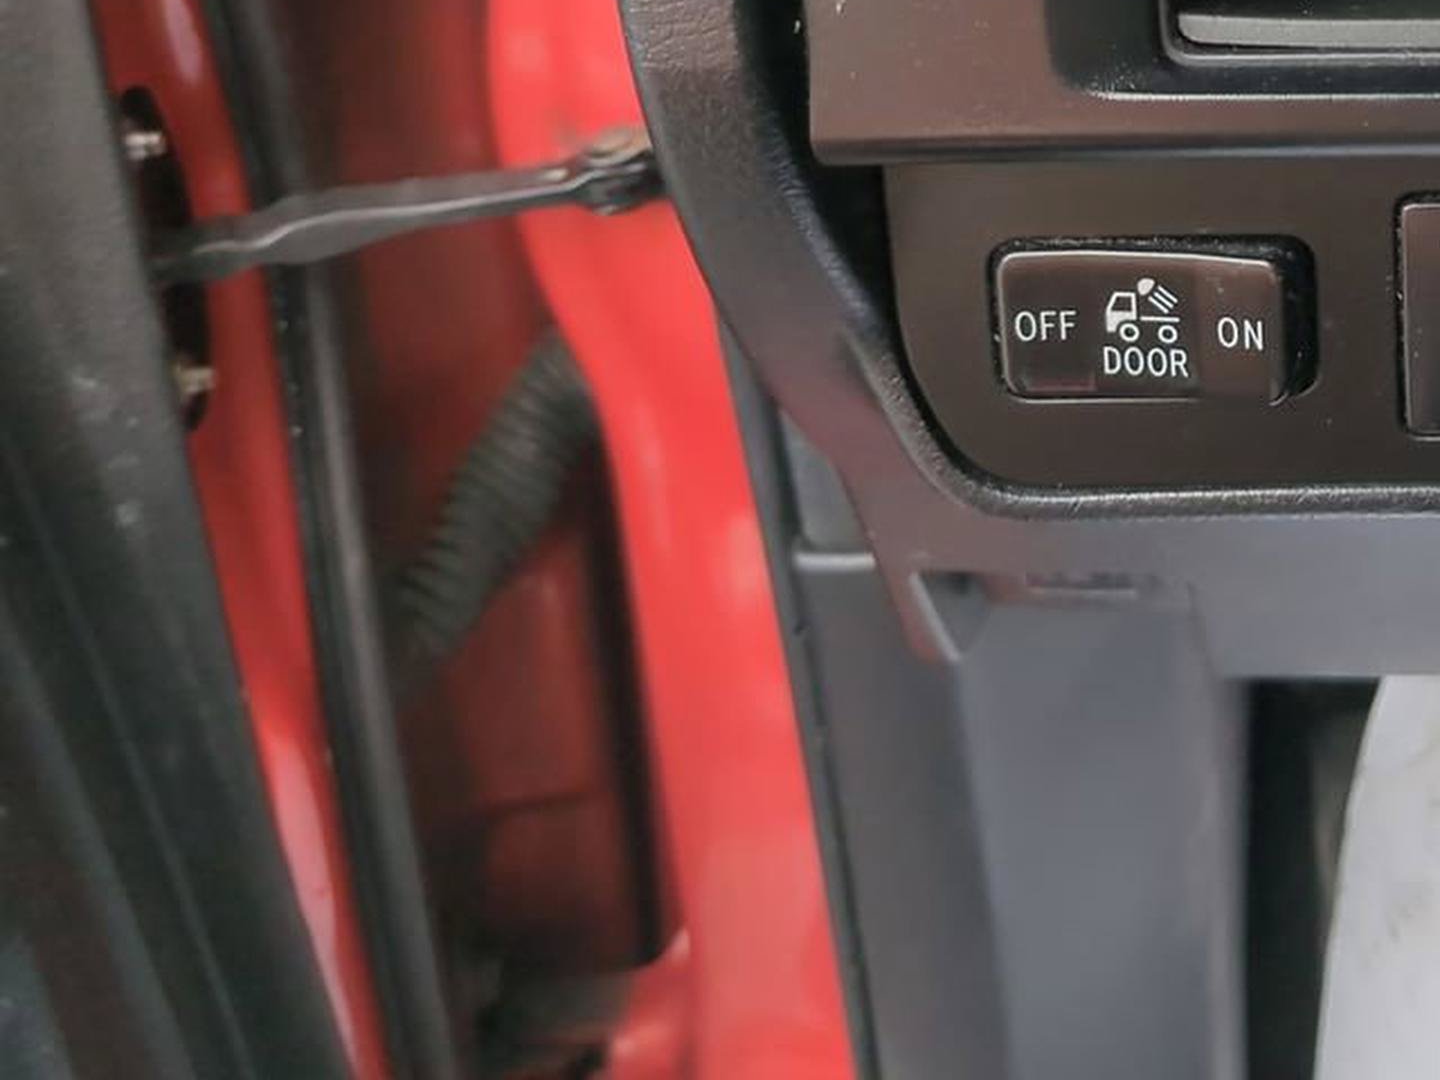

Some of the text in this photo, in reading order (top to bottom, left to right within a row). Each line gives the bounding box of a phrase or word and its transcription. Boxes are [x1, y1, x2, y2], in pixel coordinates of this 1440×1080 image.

[1014, 310, 1077, 342] OFF
[1216, 316, 1264, 351] ON
[1102, 345, 1189, 378] DOOR
